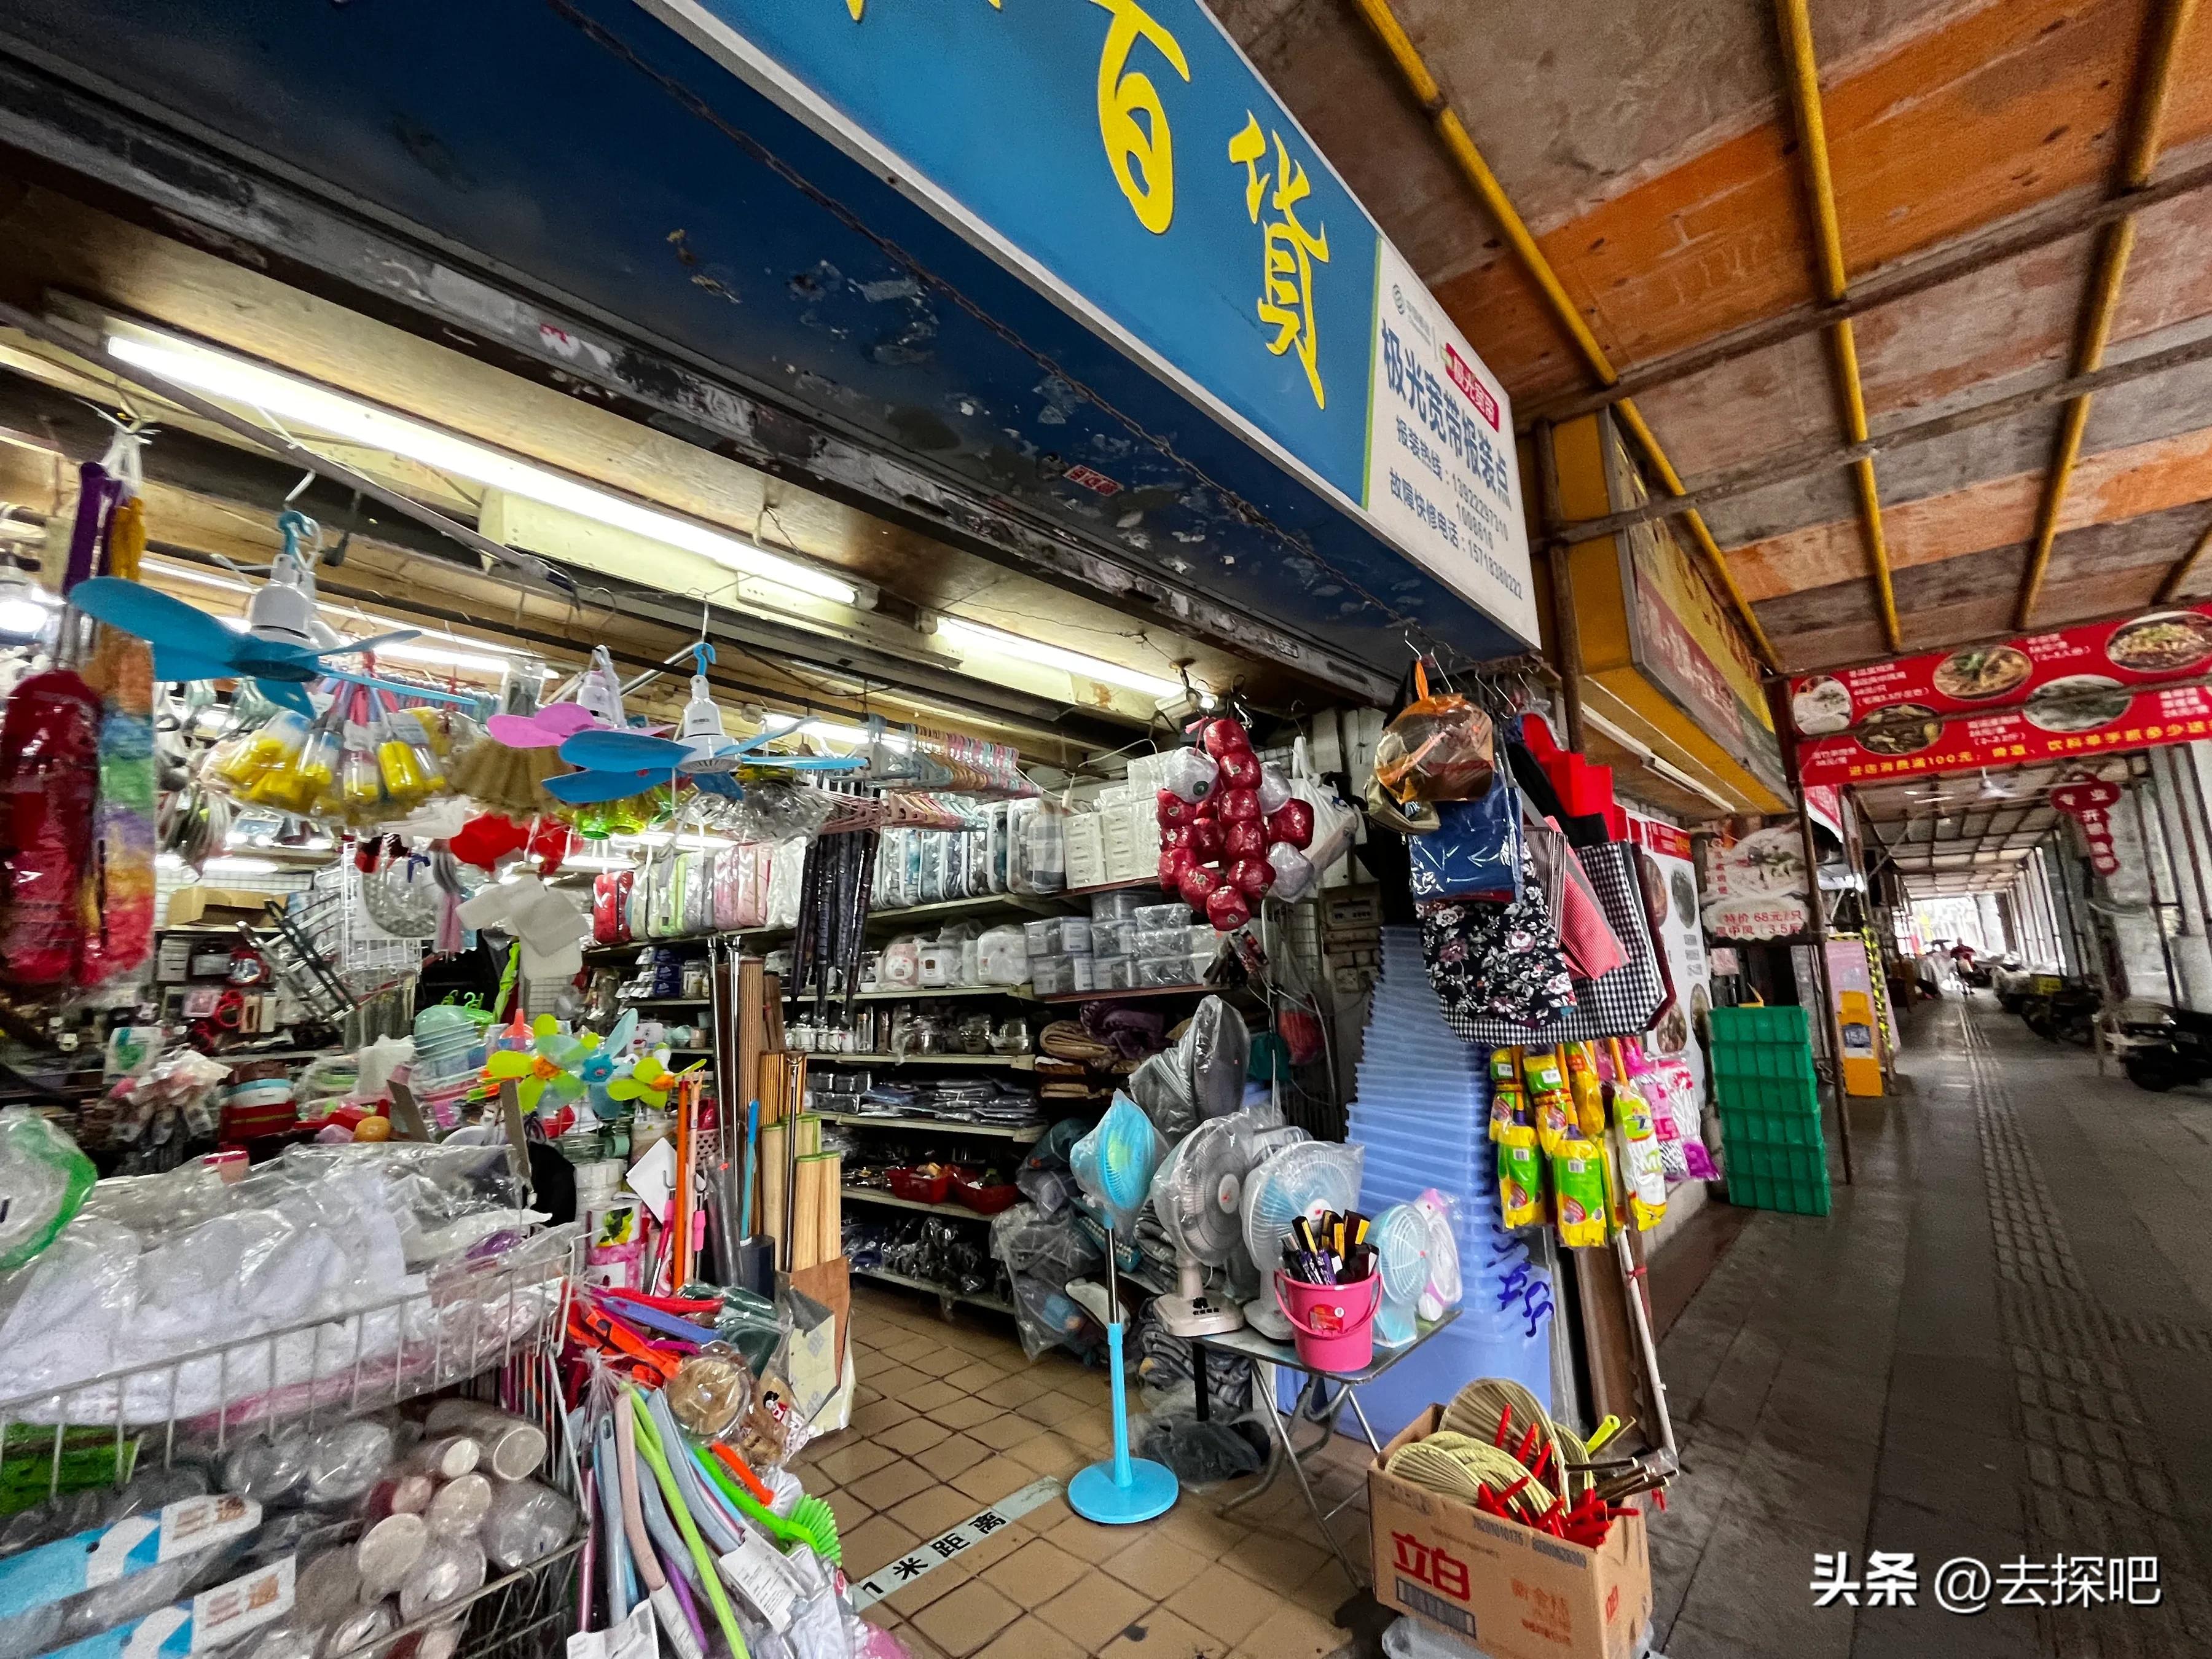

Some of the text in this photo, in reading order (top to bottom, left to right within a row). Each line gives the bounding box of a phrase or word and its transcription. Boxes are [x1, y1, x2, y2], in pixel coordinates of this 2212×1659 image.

[1381, 317, 1512, 511] 极光宽带报装点
[862, 1511, 1007, 1594] 1米距离
[1392, 1531, 1470, 1602] 立白
